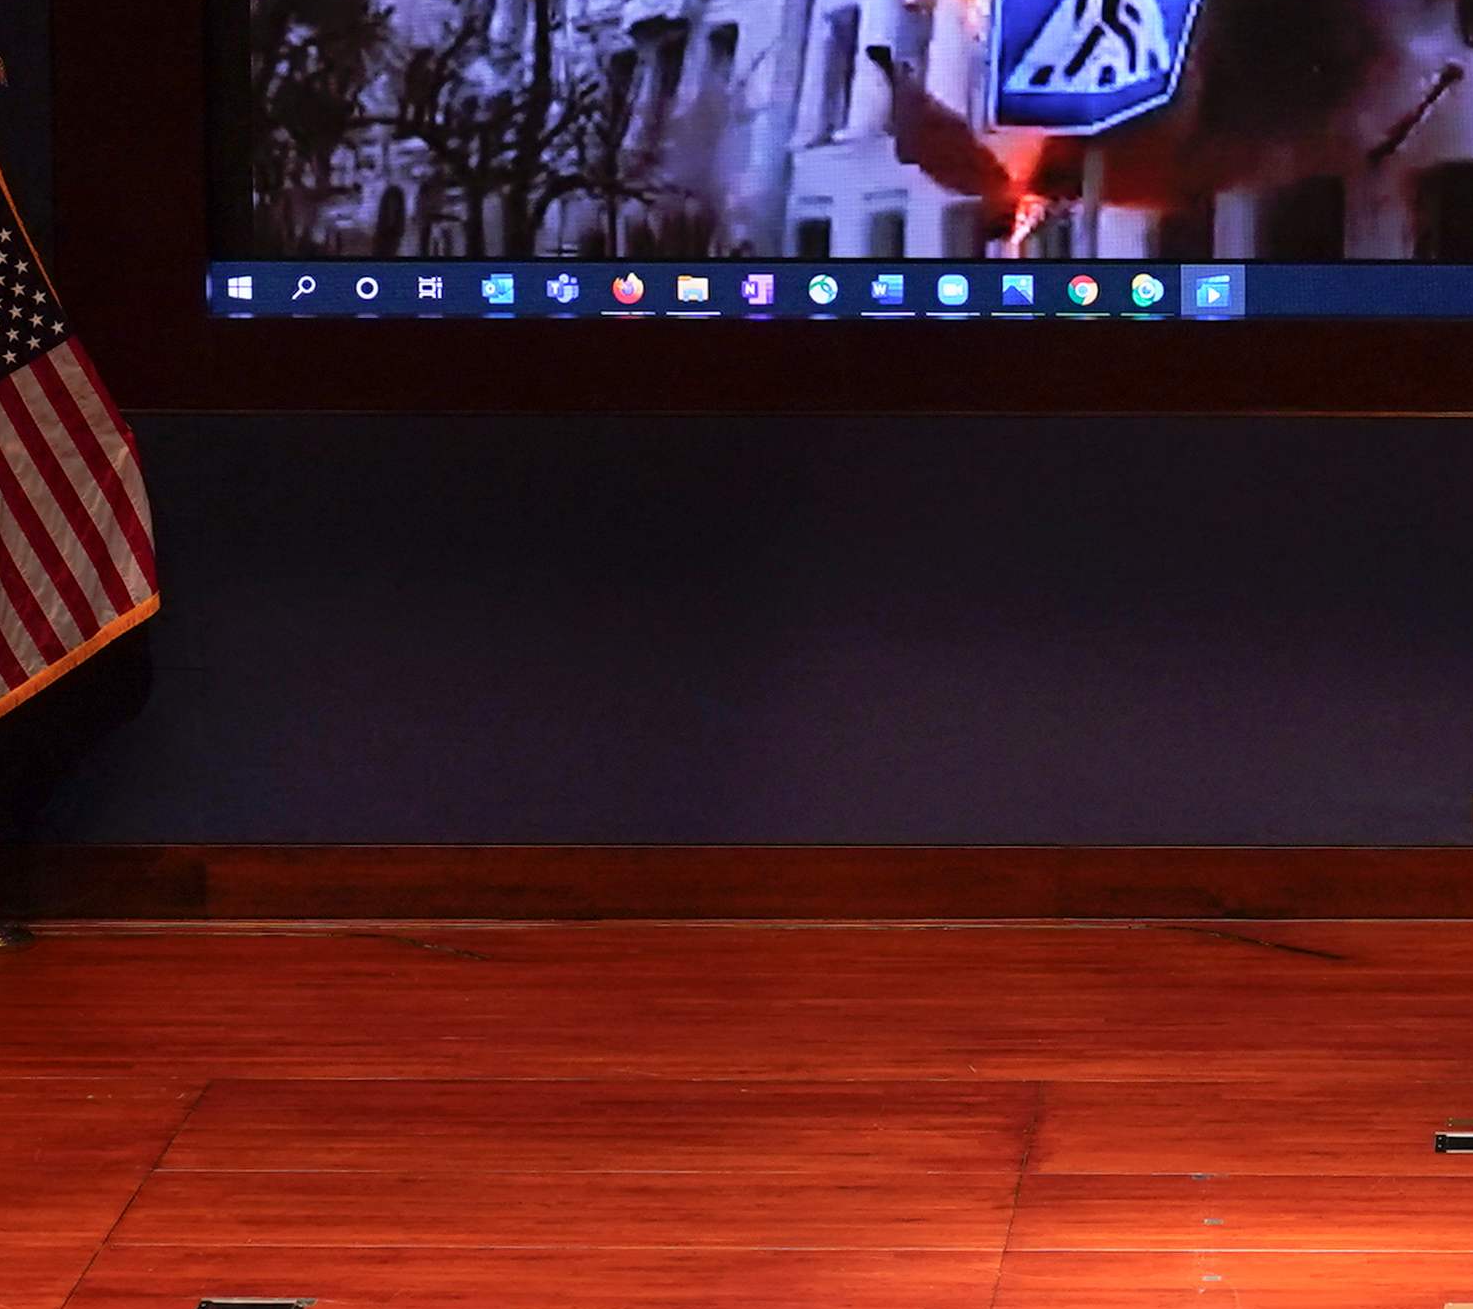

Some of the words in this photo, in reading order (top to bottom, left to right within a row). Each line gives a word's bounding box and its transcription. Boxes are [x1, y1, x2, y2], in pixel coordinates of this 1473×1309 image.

[551, 282, 560, 295] T
[744, 284, 756, 295] N
[872, 282, 888, 296] W
